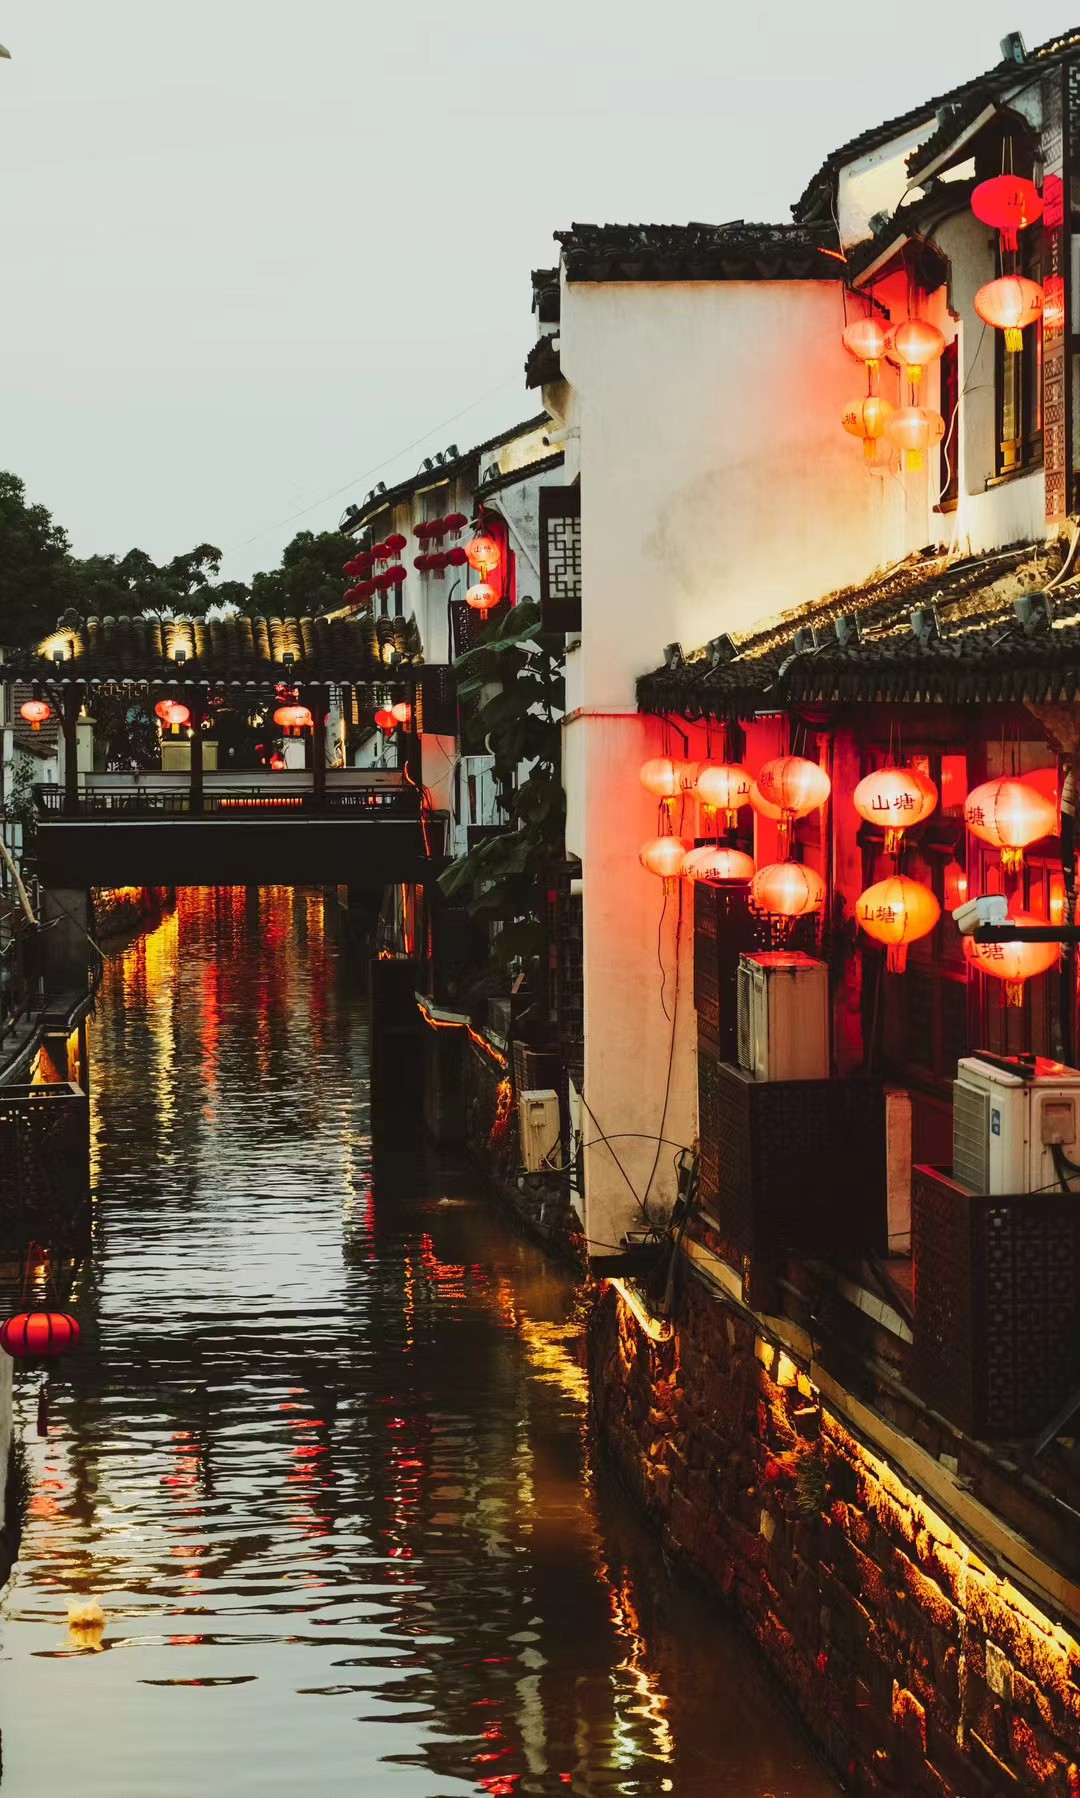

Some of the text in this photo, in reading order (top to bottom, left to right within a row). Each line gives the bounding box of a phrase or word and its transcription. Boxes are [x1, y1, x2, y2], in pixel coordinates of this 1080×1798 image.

[737, 782, 750, 795] 山
[872, 793, 915, 811] 山塘
[965, 805, 985, 827] 塘
[861, 904, 898, 924] 山塘
